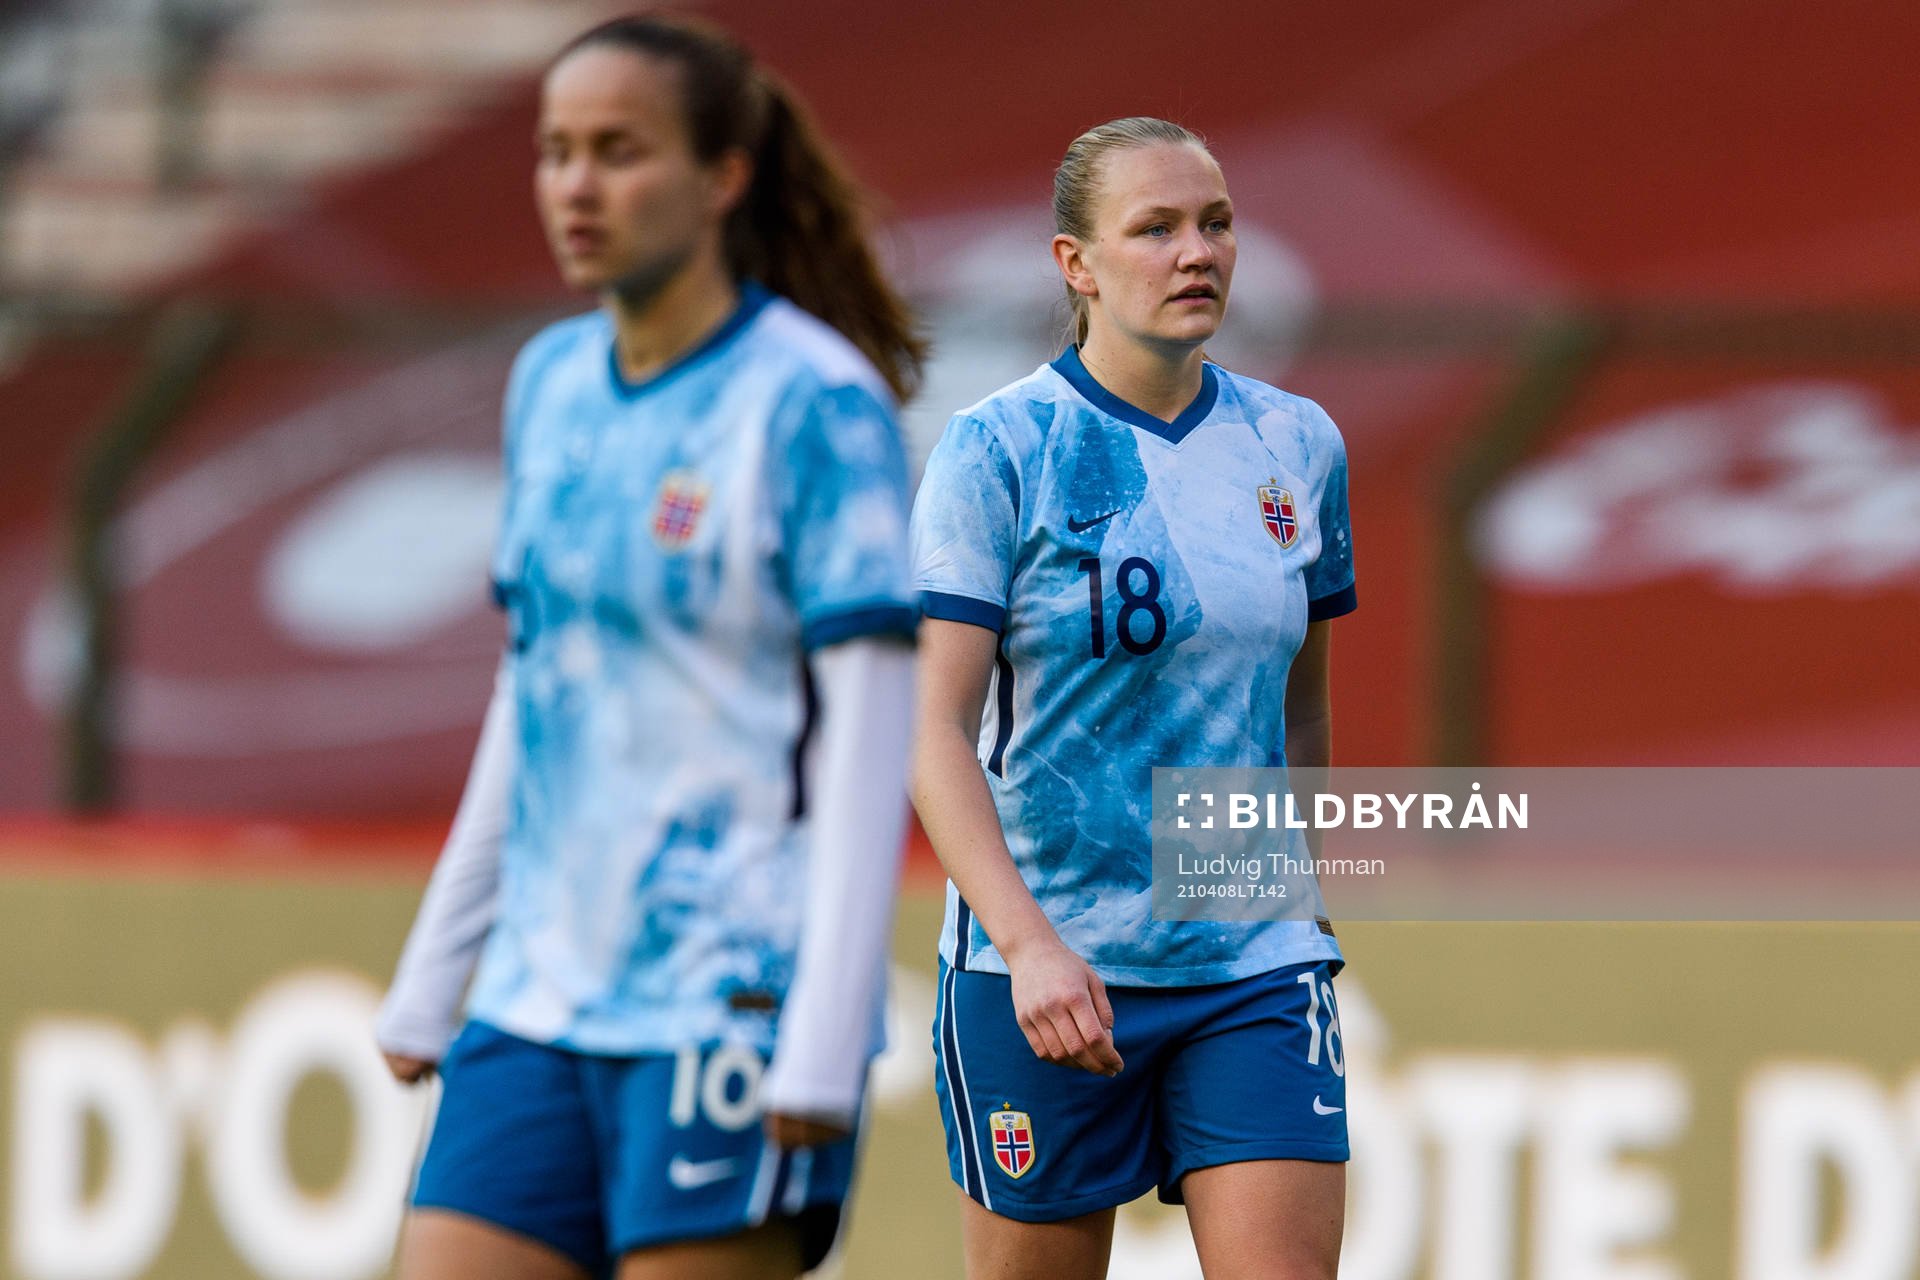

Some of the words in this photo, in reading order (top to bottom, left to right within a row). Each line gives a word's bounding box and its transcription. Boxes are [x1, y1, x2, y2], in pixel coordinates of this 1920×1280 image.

[1077, 556, 1167, 659] 18
[1297, 972, 1345, 1078] 18
[670, 1046, 764, 1131] 10
